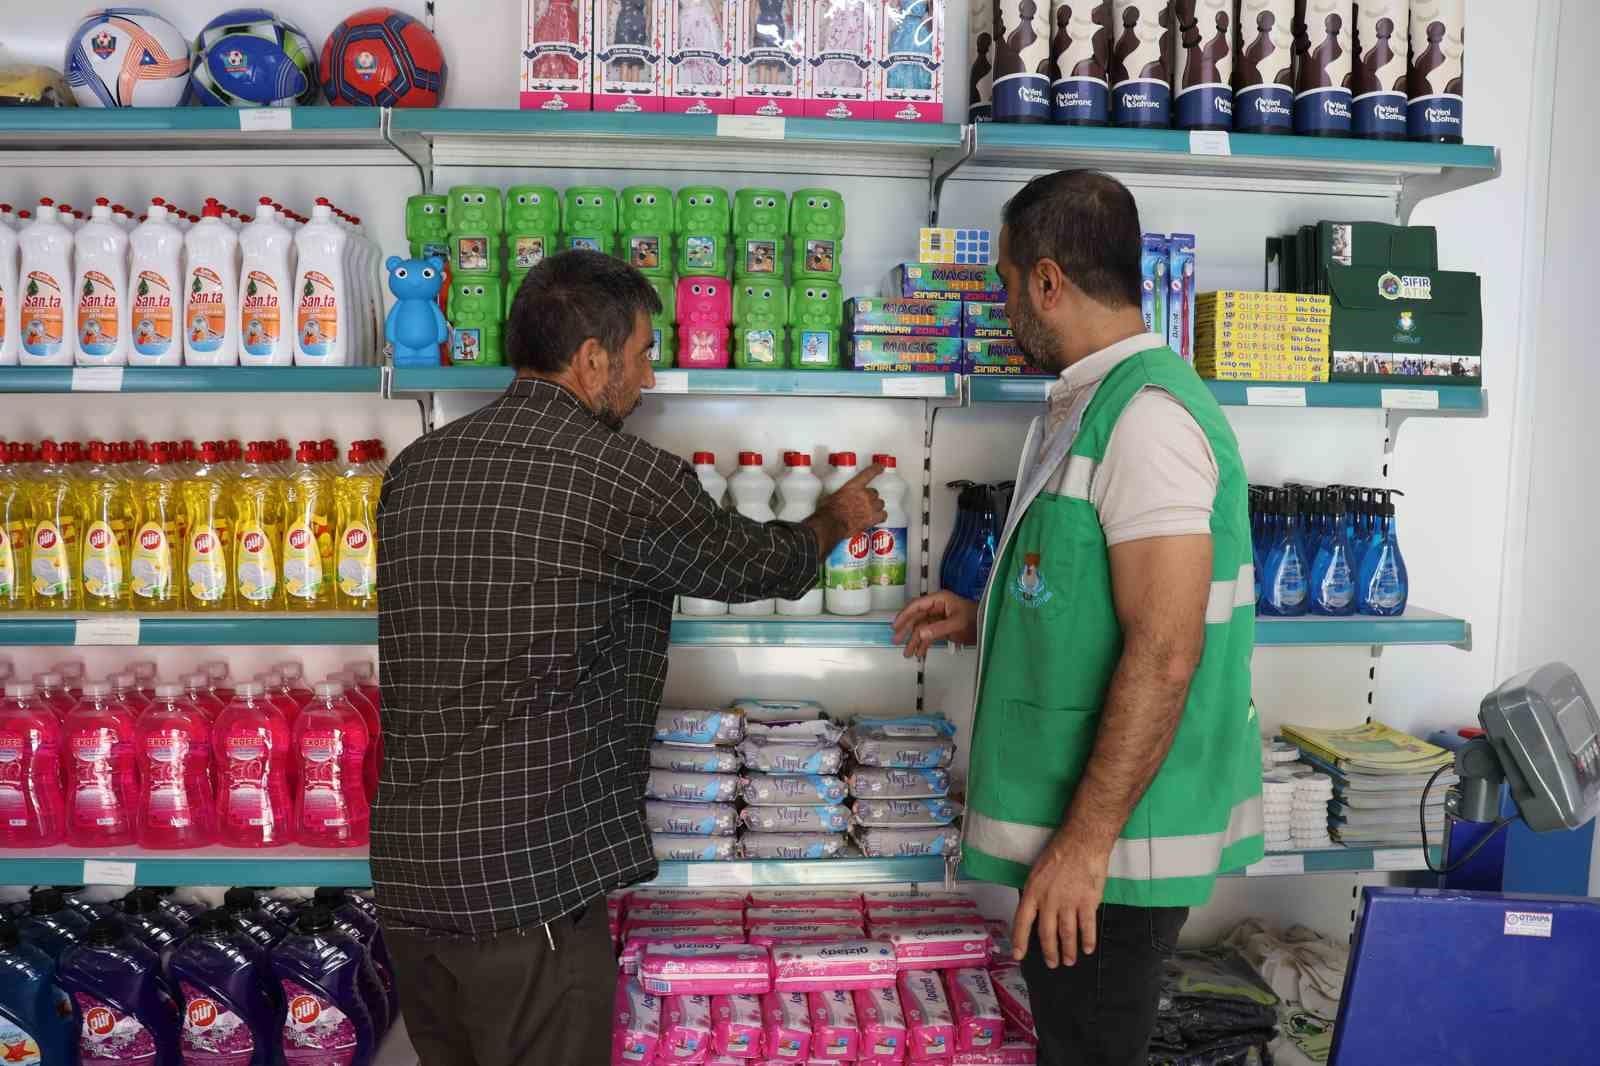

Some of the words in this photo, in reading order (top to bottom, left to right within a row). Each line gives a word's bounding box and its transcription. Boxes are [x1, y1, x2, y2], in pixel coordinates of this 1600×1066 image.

[932, 269, 986, 281] MAGIC
[1402, 277, 1430, 288] SIFIR
[882, 303, 938, 314] MAGIC
[882, 342, 938, 353] MAGIC
[348, 531, 365, 545] pür
[820, 946, 868, 957] gizlady
[191, 1004, 212, 1022] pür
[294, 1000, 316, 1018] pür
[90, 1012, 110, 1030] pür
